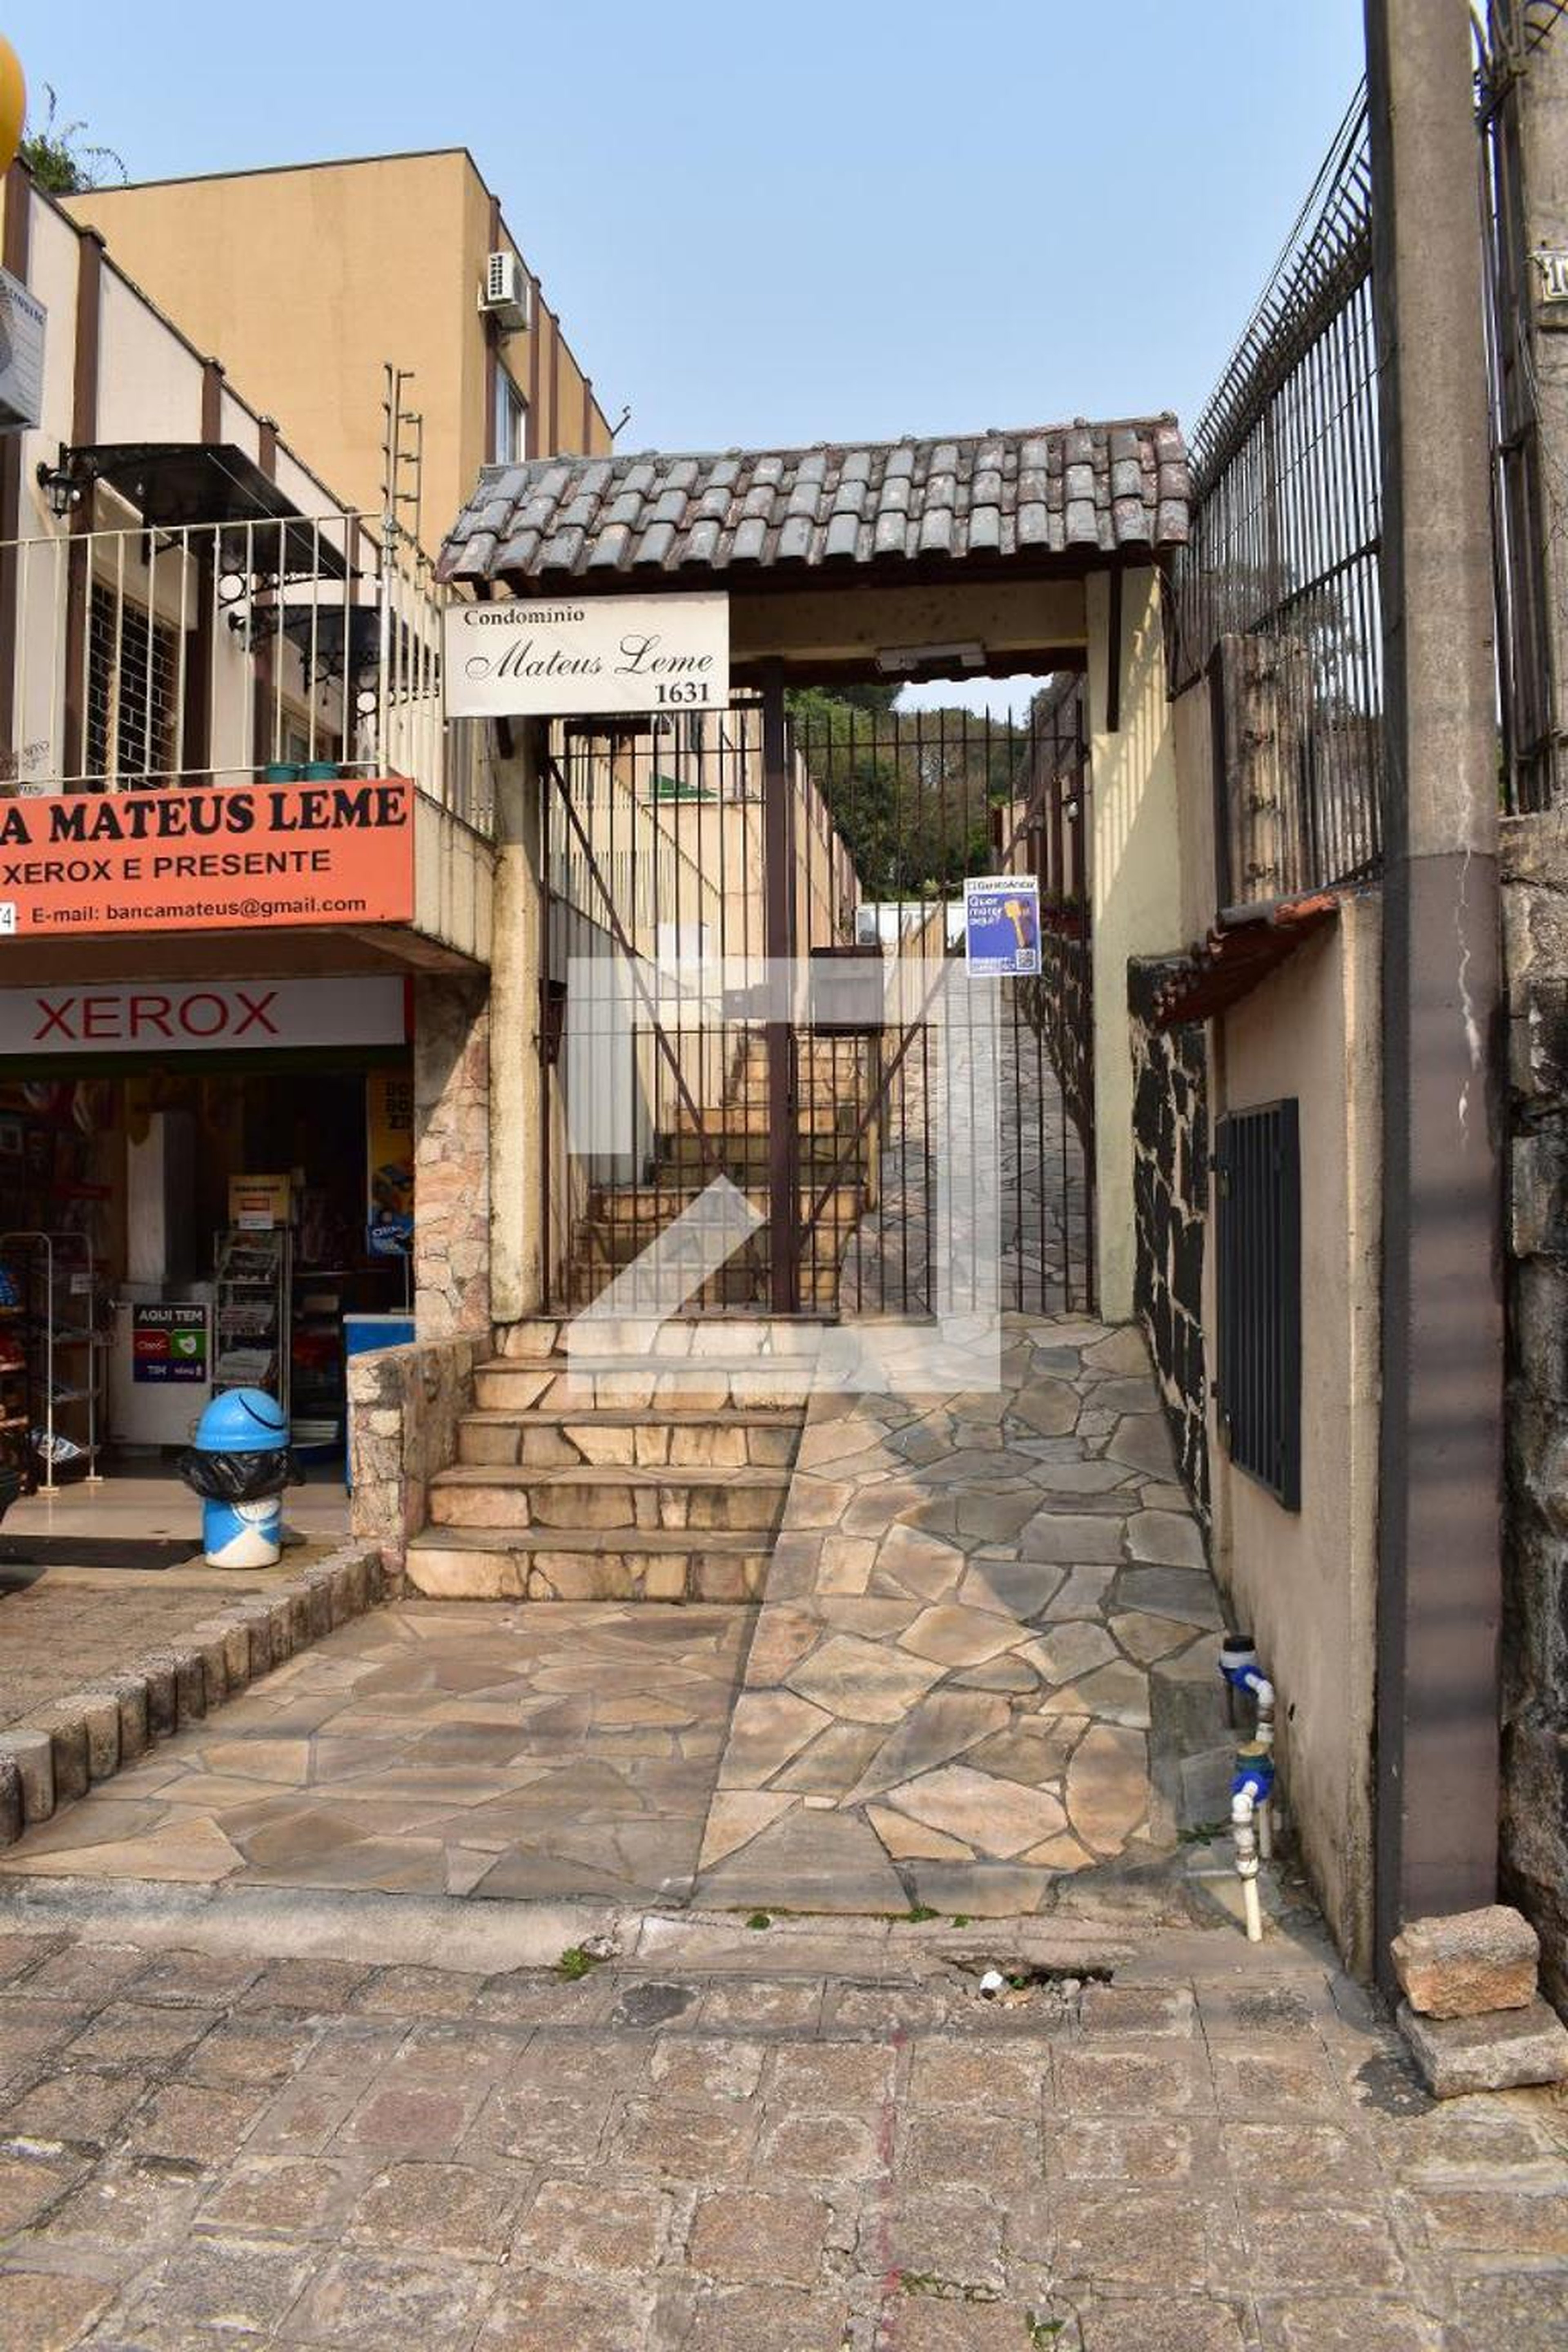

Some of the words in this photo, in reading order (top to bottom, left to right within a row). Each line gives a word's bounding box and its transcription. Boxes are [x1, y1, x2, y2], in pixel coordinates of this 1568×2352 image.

[464, 606, 584, 625] Condominio
[465, 639, 602, 679] Mateus
[614, 635, 713, 674] Leme
[655, 682, 709, 703] 1631
[0, 806, 32, 845] A
[49, 794, 254, 842] MATEUS
[269, 786, 407, 831] LEME
[3, 859, 111, 885] XEROX
[124, 858, 141, 879] E
[154, 849, 331, 878] PRESENTE
[32, 906, 98, 923] E-mail:
[107, 896, 366, 920] bancamateus@gmail.com
[33, 992, 279, 1040] XEROX
[138, 1309, 173, 1322] AQUI
[175, 1310, 203, 1322] TEM
